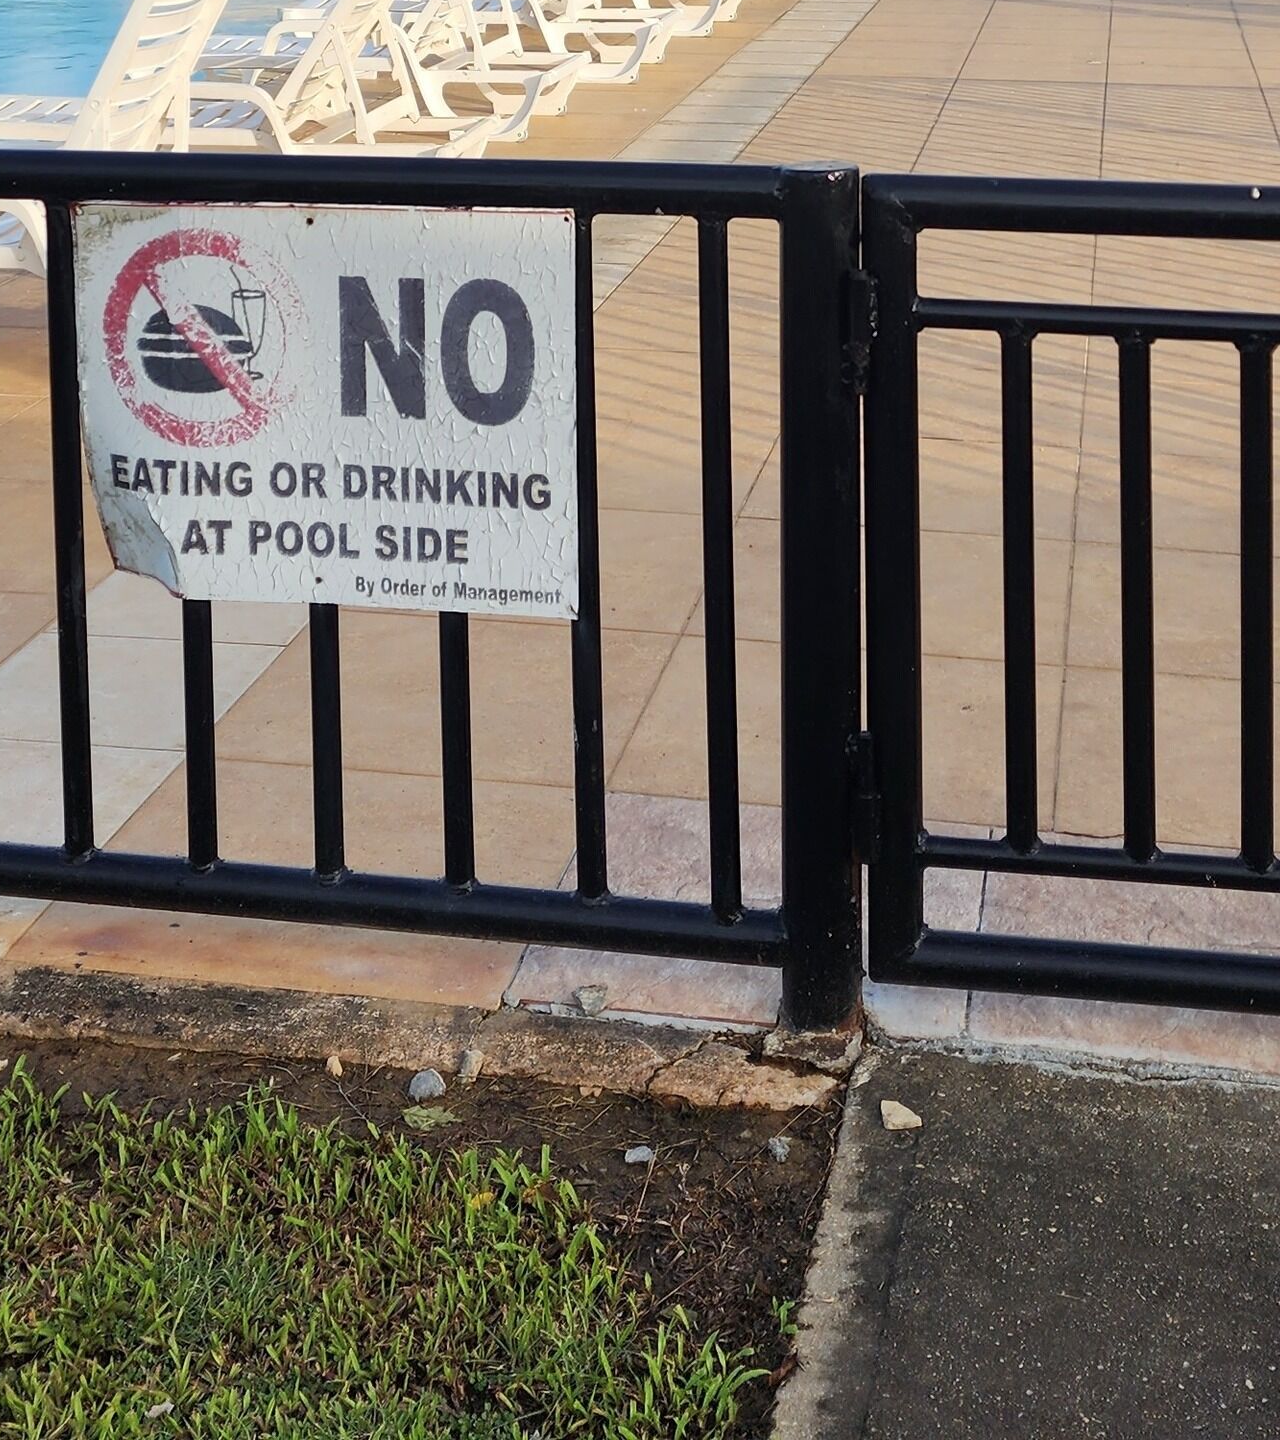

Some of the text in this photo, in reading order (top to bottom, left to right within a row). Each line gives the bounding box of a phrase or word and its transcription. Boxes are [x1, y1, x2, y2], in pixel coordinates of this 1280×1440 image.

[338, 274, 536, 427] NO
[109, 453, 552, 511] EATING OR DRINKING
[180, 518, 469, 565] AT POOL SIDE
[355, 576, 562, 605] By Order of Management
